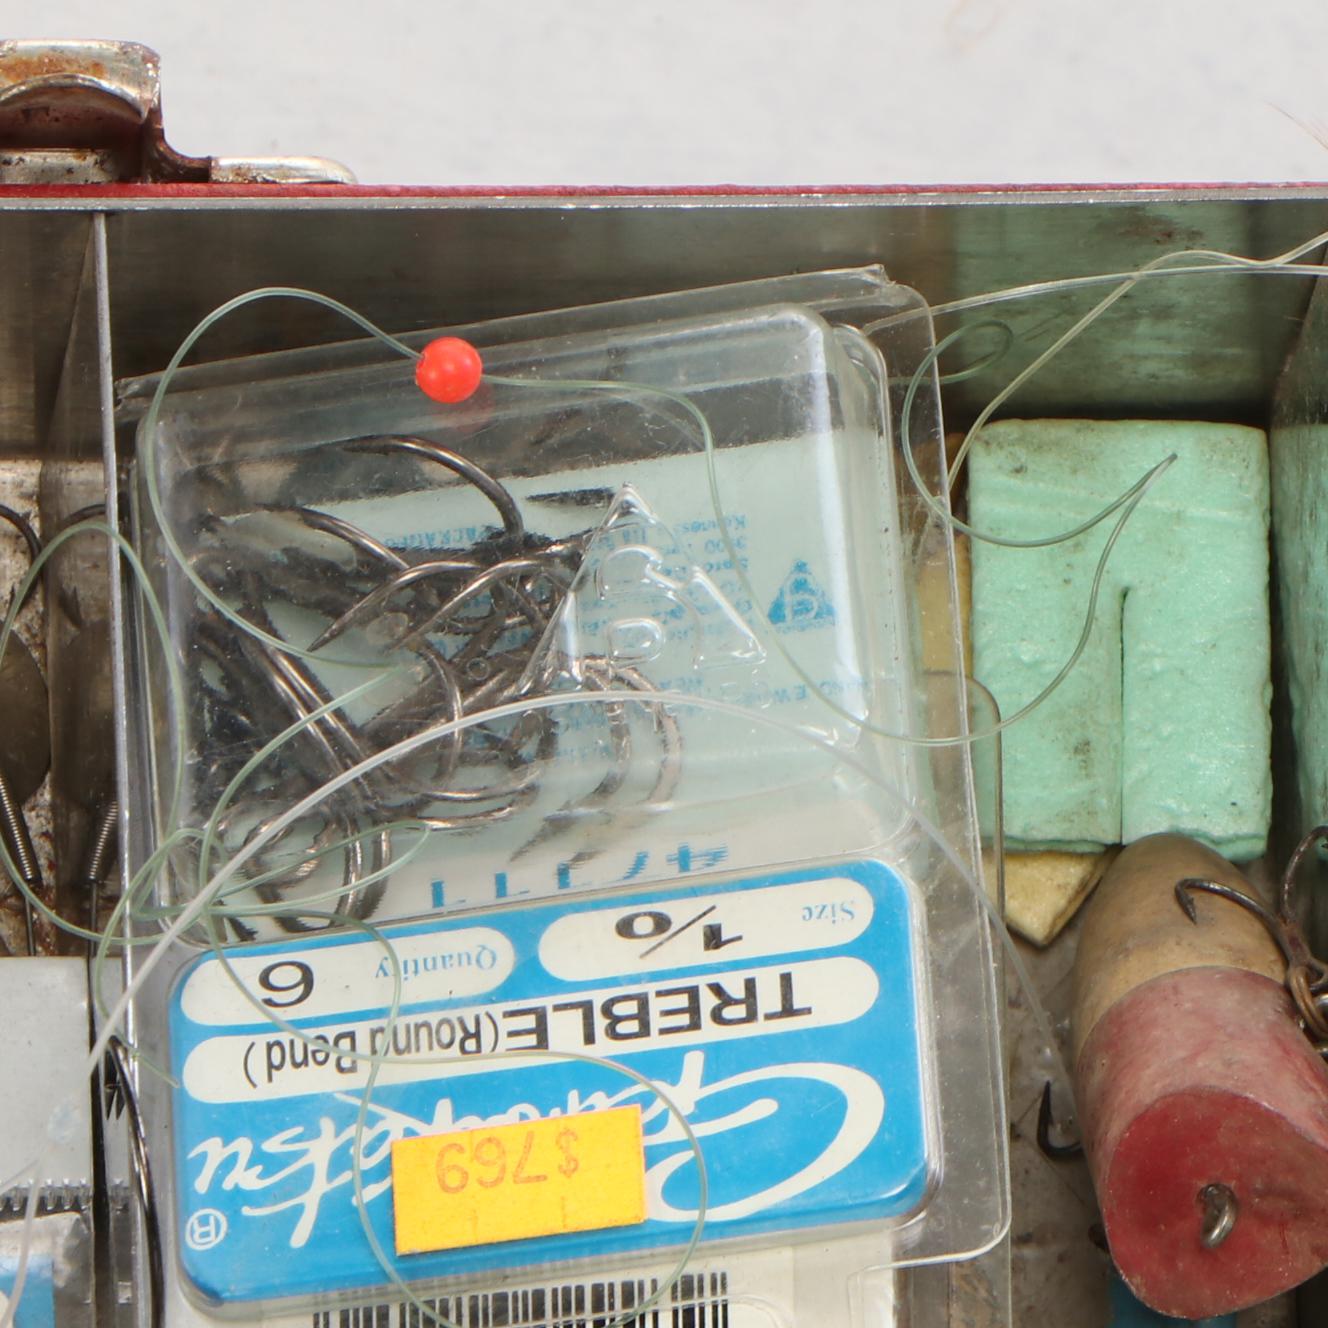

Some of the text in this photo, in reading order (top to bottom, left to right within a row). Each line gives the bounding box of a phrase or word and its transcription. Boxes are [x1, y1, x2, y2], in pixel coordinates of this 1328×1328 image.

[614, 900, 857, 961] Size 1/0
[256, 946, 498, 1009] Quantity 6
[502, 972, 811, 1054] TREBLE
[242, 1028, 356, 1089] Bend)
